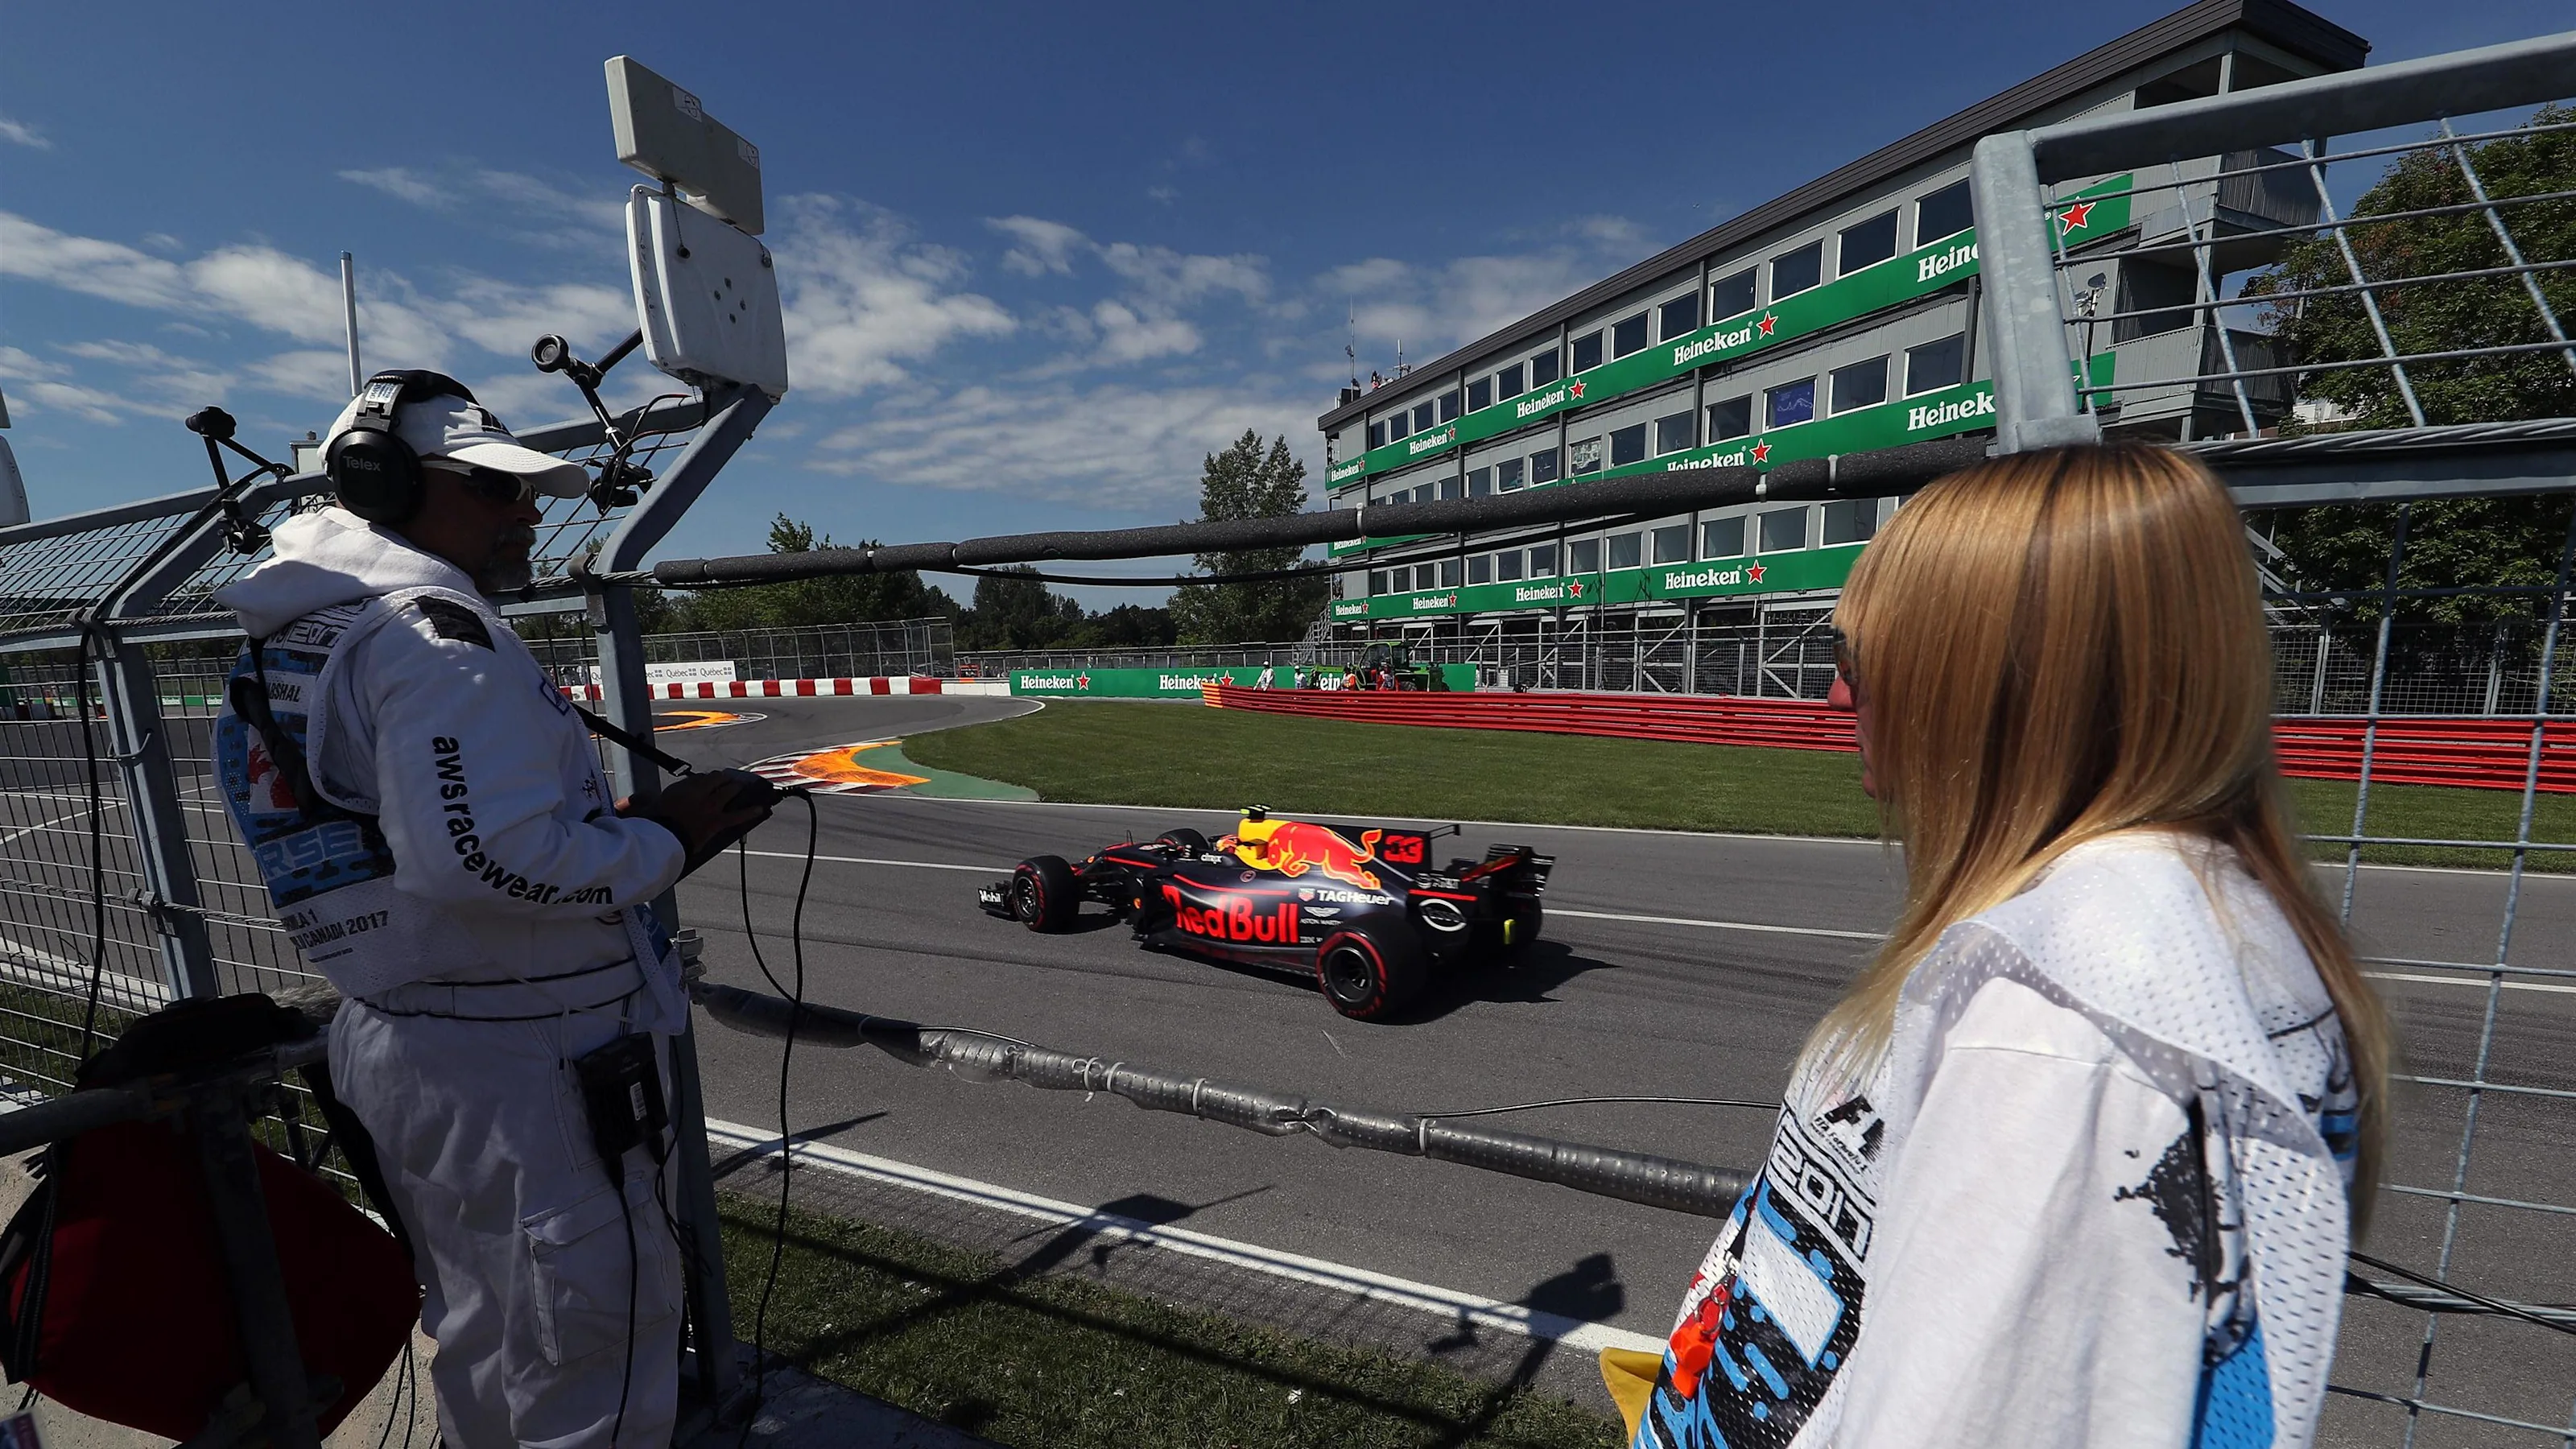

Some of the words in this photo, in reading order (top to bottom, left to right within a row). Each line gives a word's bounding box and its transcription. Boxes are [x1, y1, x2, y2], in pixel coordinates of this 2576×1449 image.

[1672, 324, 1752, 366] Heineken
[1515, 387, 1566, 419] Heineken
[1907, 391, 1996, 431] Heinek
[1408, 428, 1447, 456] Heineken
[343, 456, 381, 472] Telex
[1329, 461, 1359, 483] Heineken
[1665, 568, 1741, 590] Heineken
[1413, 595, 1449, 610] Heineken
[1515, 584, 1565, 602] Heineken
[1335, 604, 1363, 616] Heineken
[667, 669, 688, 679] Québec
[700, 667, 724, 678] Québec
[1020, 675, 1074, 690] Heineken
[1159, 674, 1216, 690] Heinek
[431, 737, 614, 906] awsracewear.com
[1384, 835, 1423, 864] 33
[303, 922, 346, 947] CANADA
[345, 910, 389, 935] 2017
